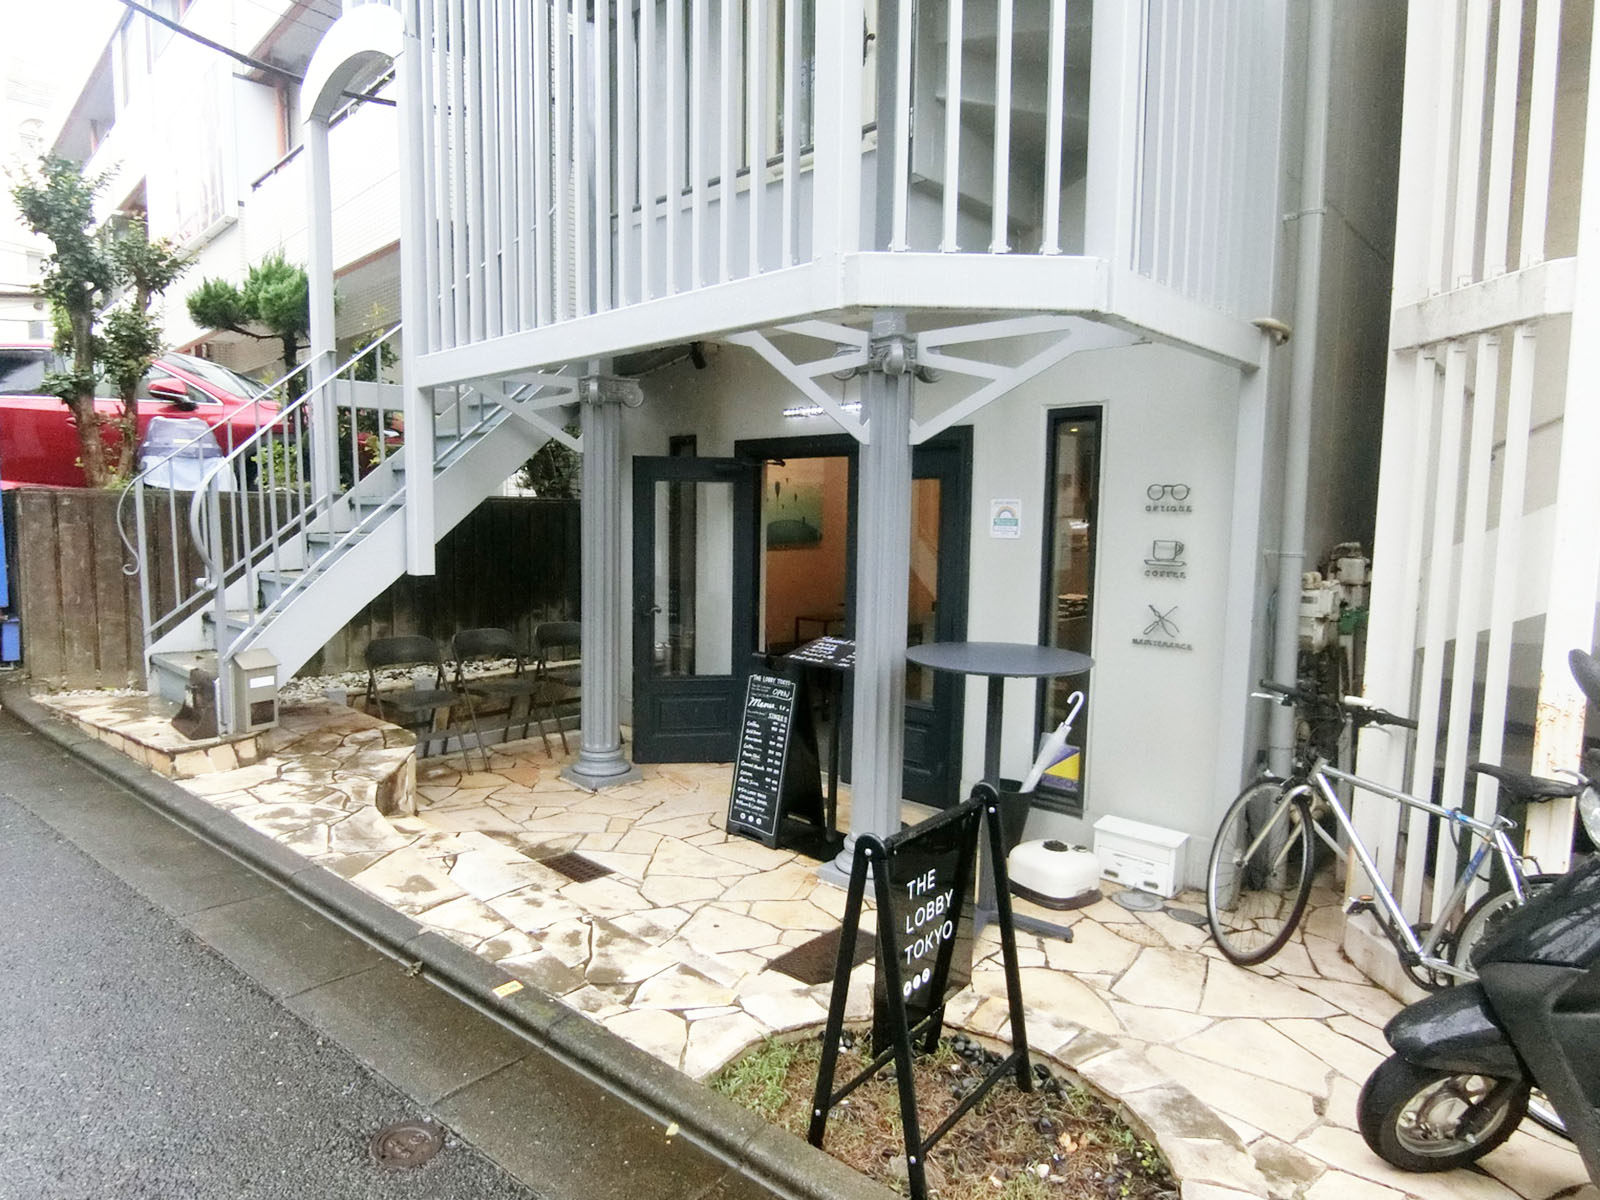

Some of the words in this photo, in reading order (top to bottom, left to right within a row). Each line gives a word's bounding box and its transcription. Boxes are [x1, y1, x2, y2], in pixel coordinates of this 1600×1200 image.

[1144, 569, 1187, 579] COFFEE
[772, 688, 791, 698] OPEN
[906, 868, 936, 900] THE
[905, 888, 954, 934] LOBBY
[904, 920, 953, 965] TOKYO
